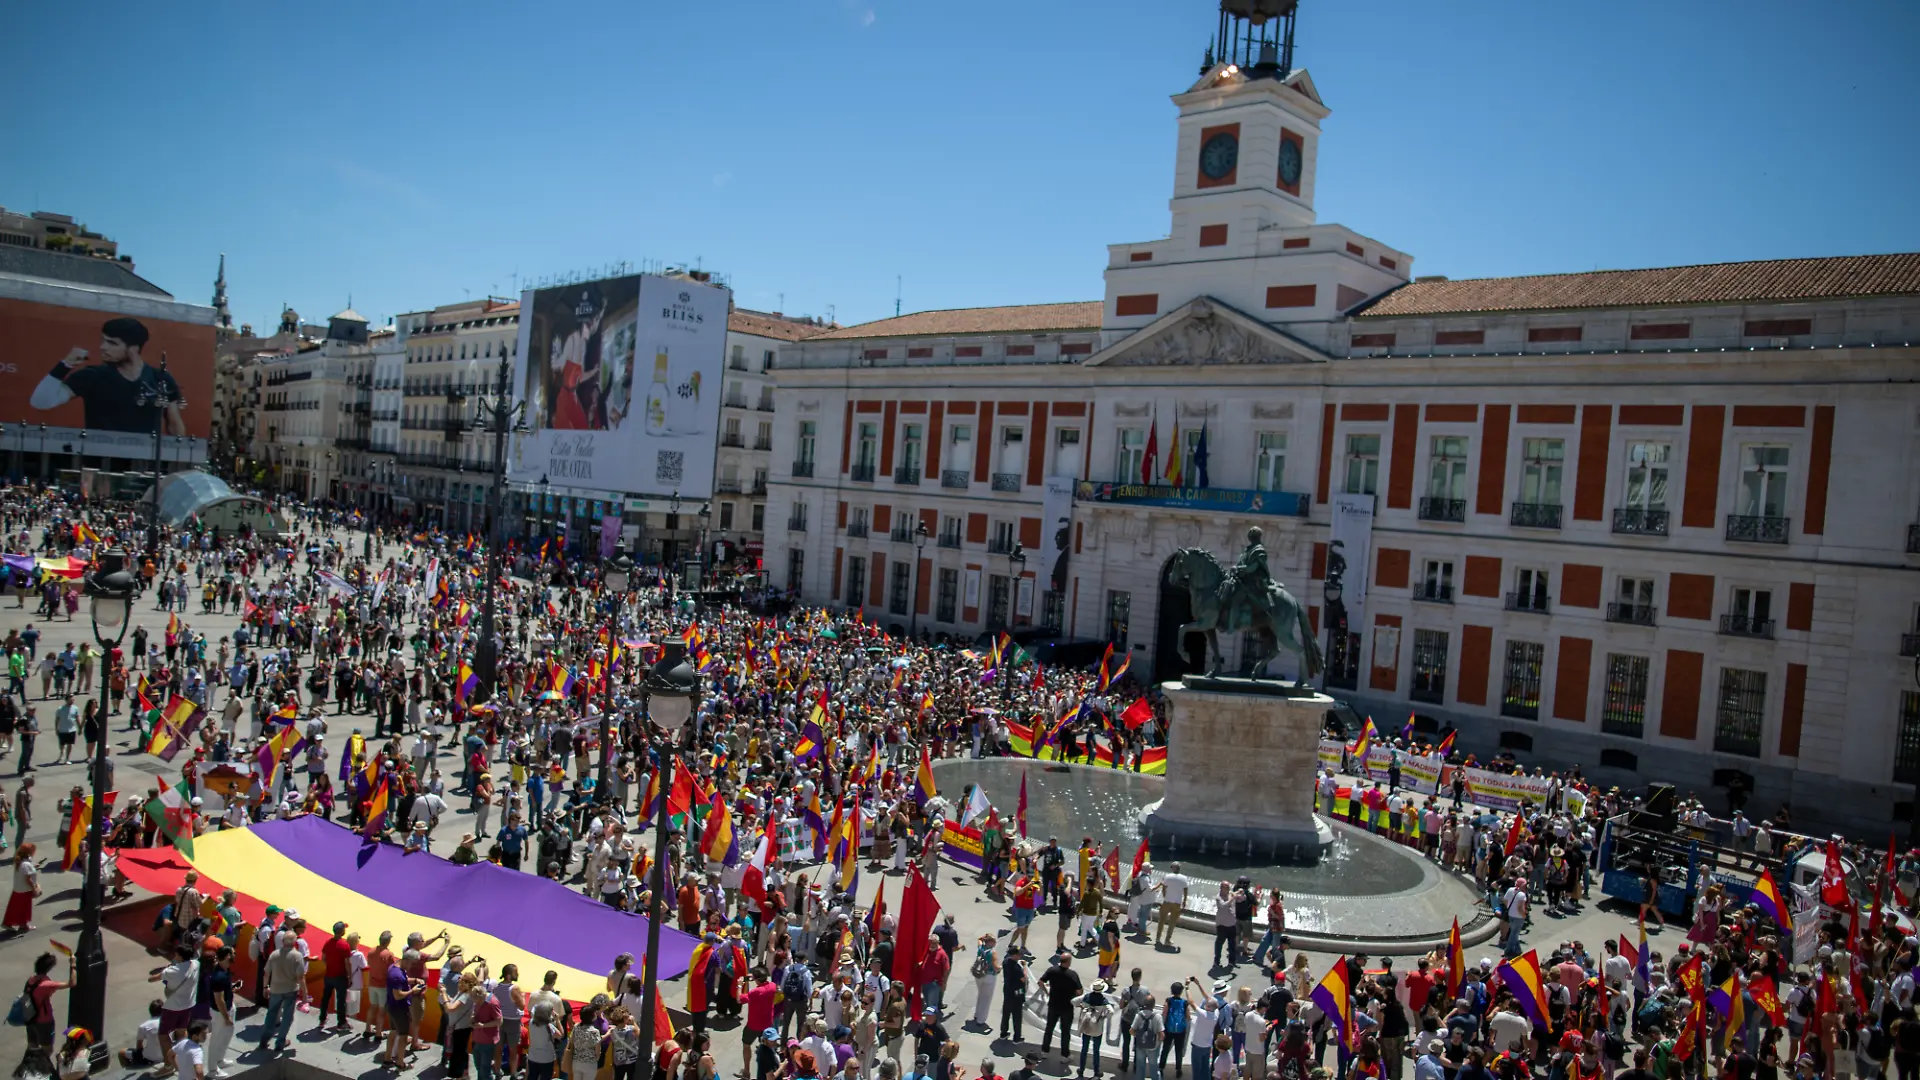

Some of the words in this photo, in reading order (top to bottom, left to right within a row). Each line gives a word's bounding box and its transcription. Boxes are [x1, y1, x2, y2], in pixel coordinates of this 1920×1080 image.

[662, 307, 705, 325] BLISS
[1318, 745, 1342, 754] ADRID
[1408, 760, 1438, 774] MADRID
[1483, 777, 1508, 788] TODAS
[1518, 783, 1548, 794] MADRID
